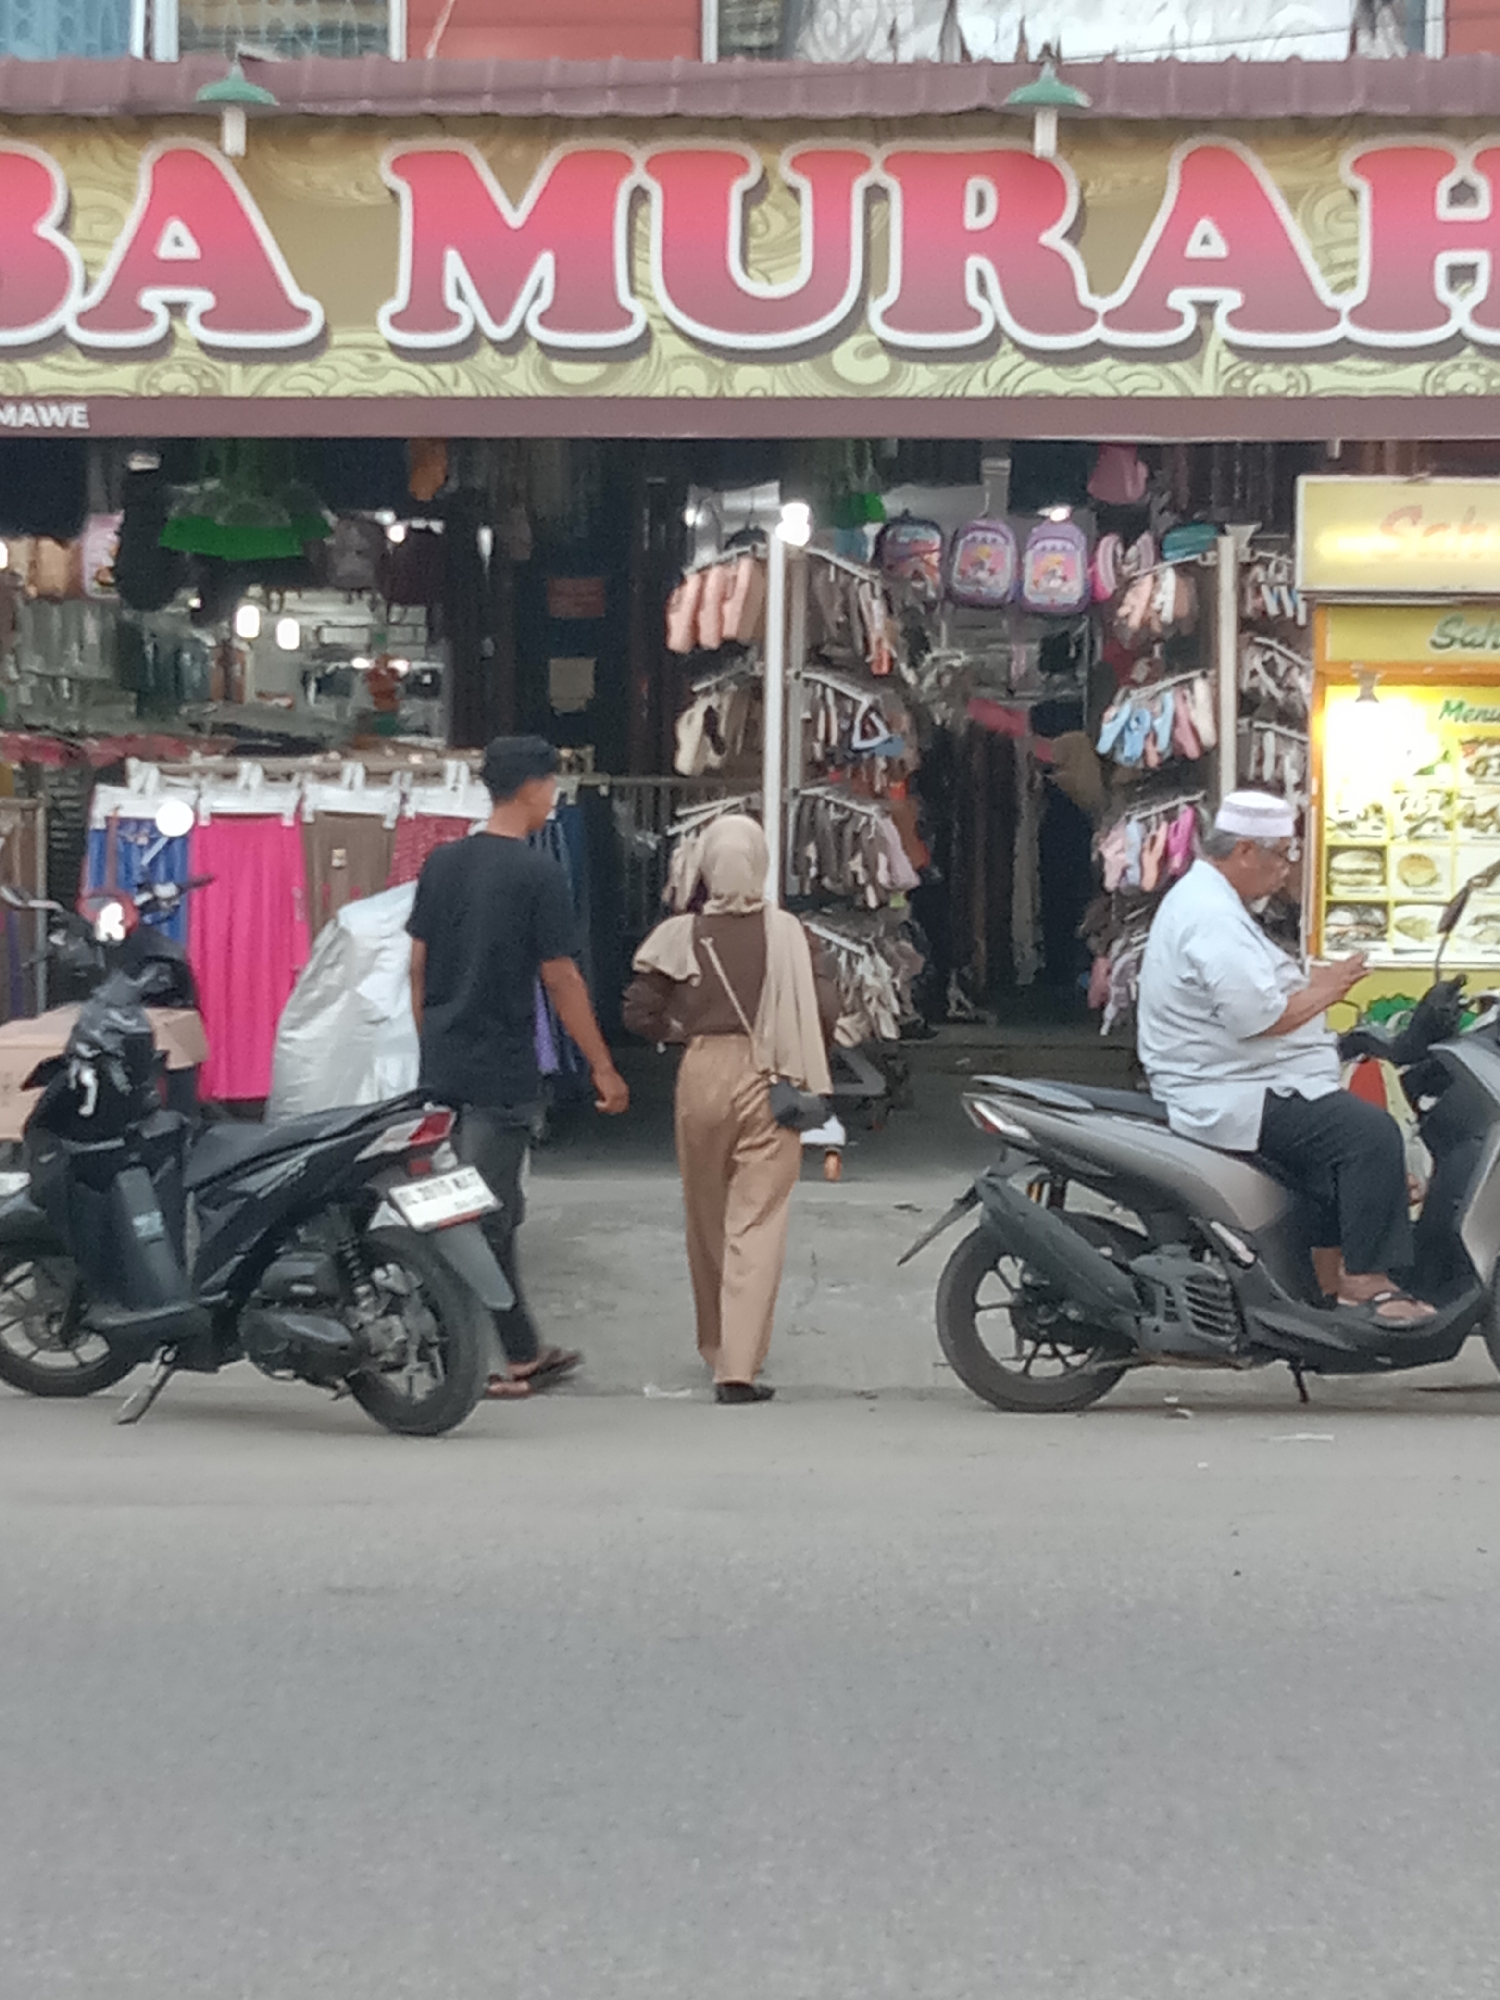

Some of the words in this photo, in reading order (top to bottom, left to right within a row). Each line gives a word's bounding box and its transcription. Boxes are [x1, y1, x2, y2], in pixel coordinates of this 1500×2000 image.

[377, 138, 1500, 350] MURAH
[0, 402, 90, 428] MAWE
[1438, 699, 1500, 723] Menu
